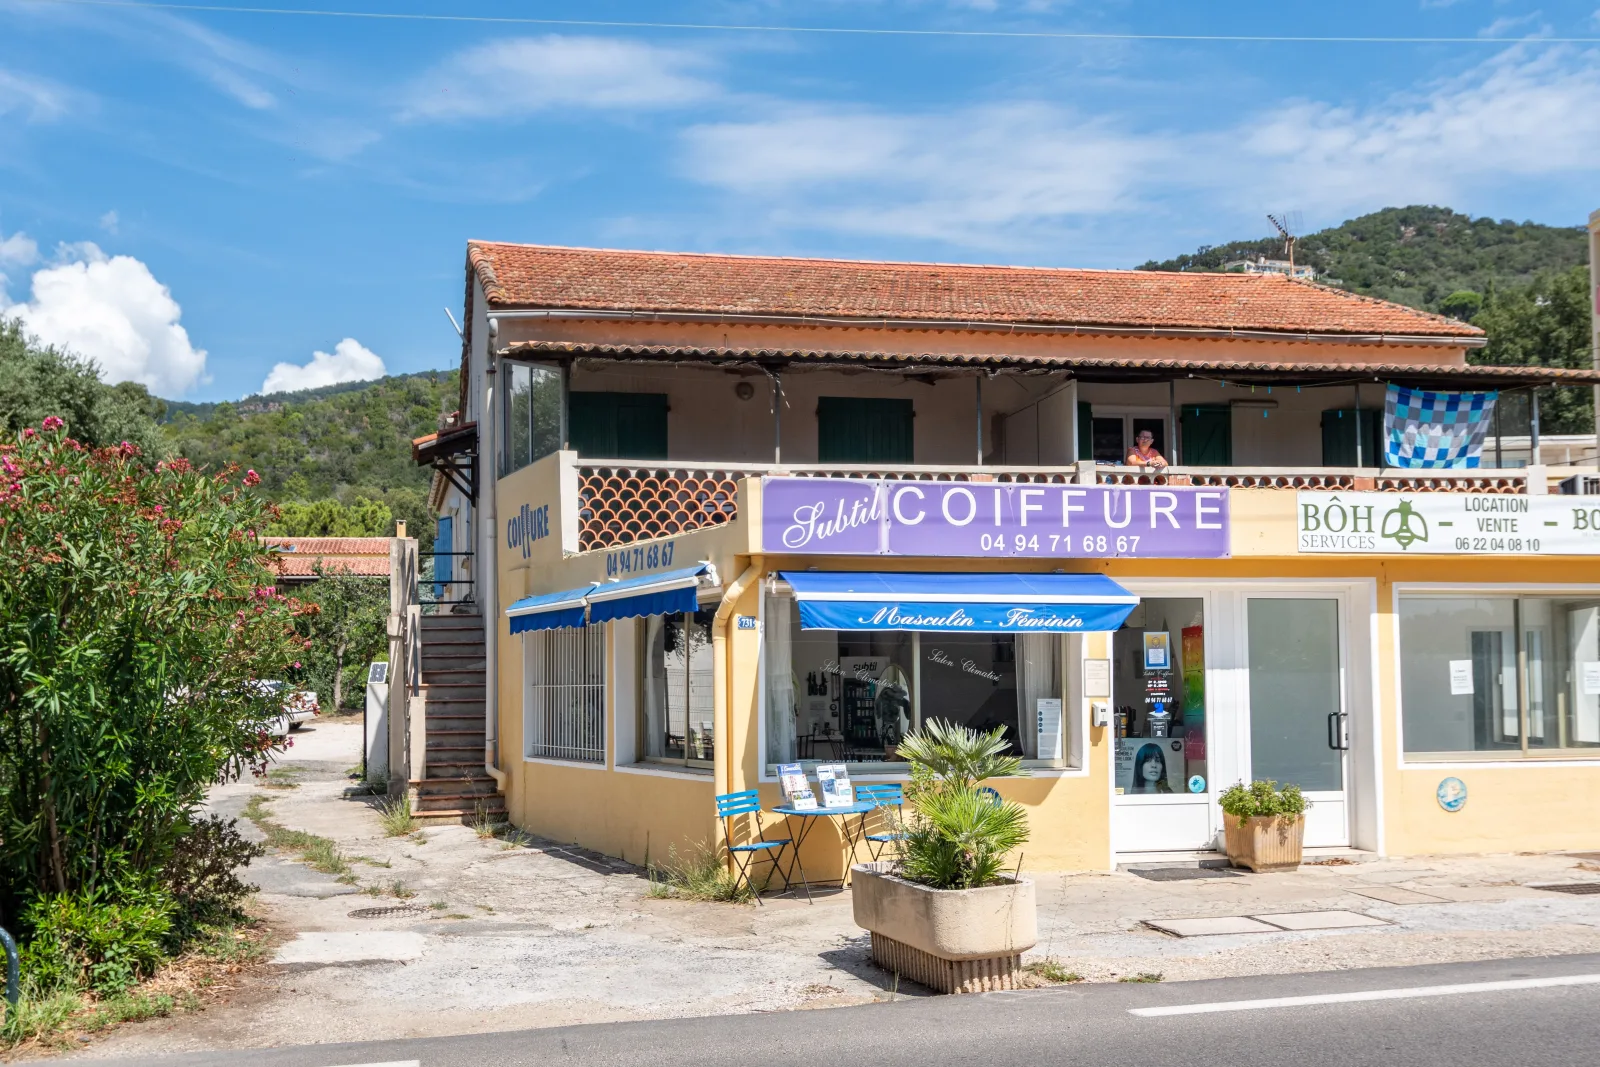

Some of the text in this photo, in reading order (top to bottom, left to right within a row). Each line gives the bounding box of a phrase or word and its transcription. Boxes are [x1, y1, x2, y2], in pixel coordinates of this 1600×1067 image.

[1301, 495, 1375, 533] BÔH
[1465, 497, 1529, 513] LOCATION
[782, 486, 1222, 549] Subtil COIFFURE
[1477, 517, 1519, 533] VENTE
[980, 533, 1141, 553] 04 94 71 68 67
[1301, 534, 1376, 550] SERVICES
[1455, 537, 1541, 552] 06 22 04 08 10
[607, 541, 674, 577] 04 94 71 68 67
[742, 618, 754, 628] 731
[858, 606, 975, 627] Masculin
[999, 607, 1084, 628] Féminin
[852, 662, 878, 672] subtil
[927, 648, 955, 667] Salon
[819, 658, 847, 677] Salon
